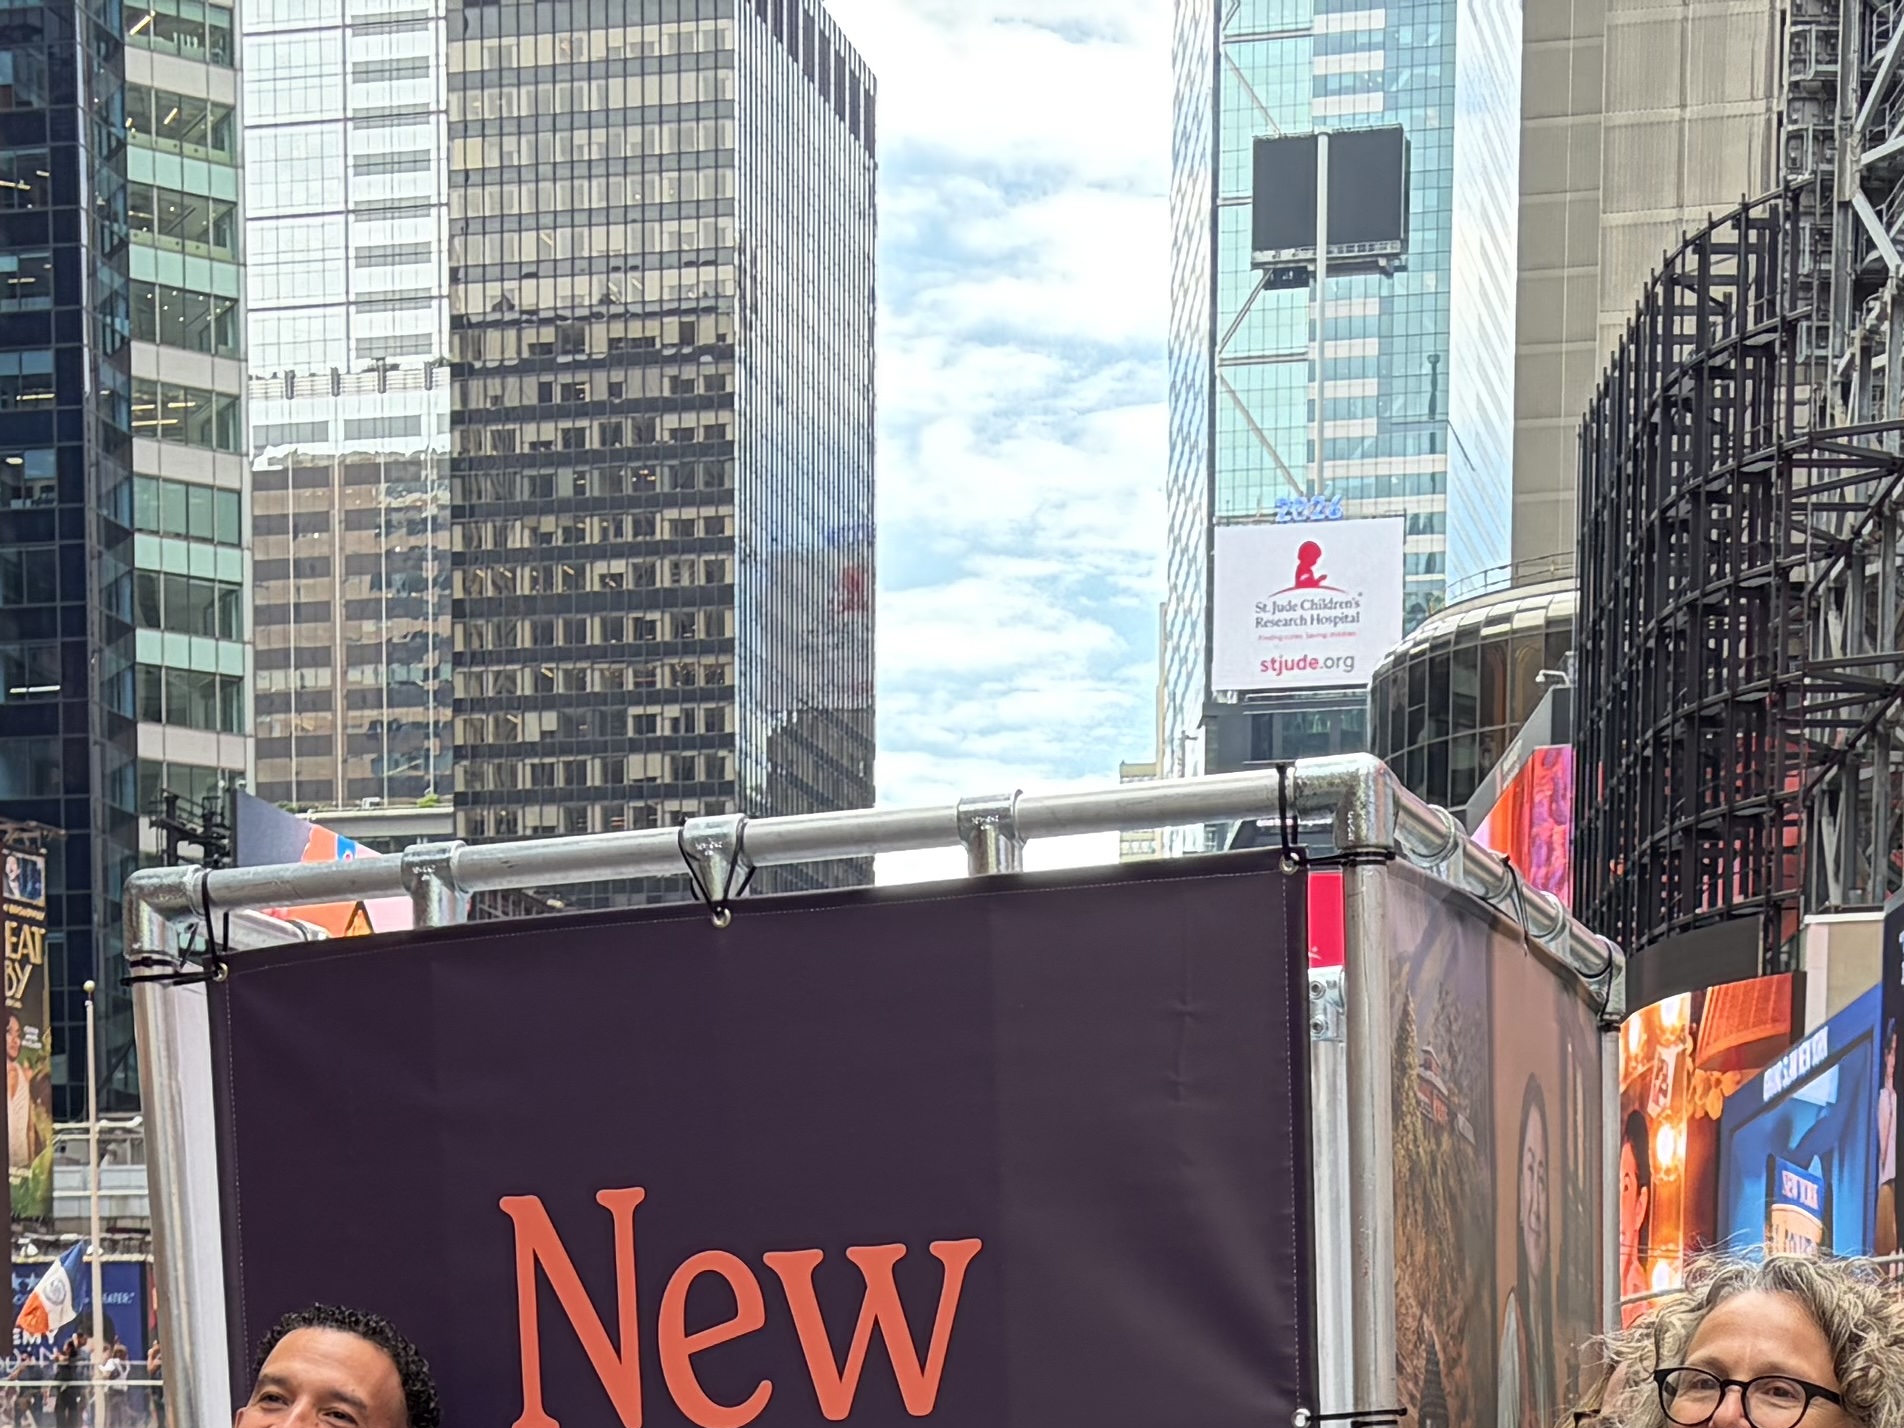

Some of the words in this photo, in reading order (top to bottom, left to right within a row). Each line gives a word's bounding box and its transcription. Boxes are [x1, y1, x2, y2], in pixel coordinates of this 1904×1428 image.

[1276, 494, 1344, 523] 2026
[1272, 599, 1298, 615] Jude
[1300, 597, 1361, 612] Children's
[1255, 616, 1308, 629] Research
[1310, 611, 1361, 629] Hospital
[1260, 654, 1355, 677] stjude.org
